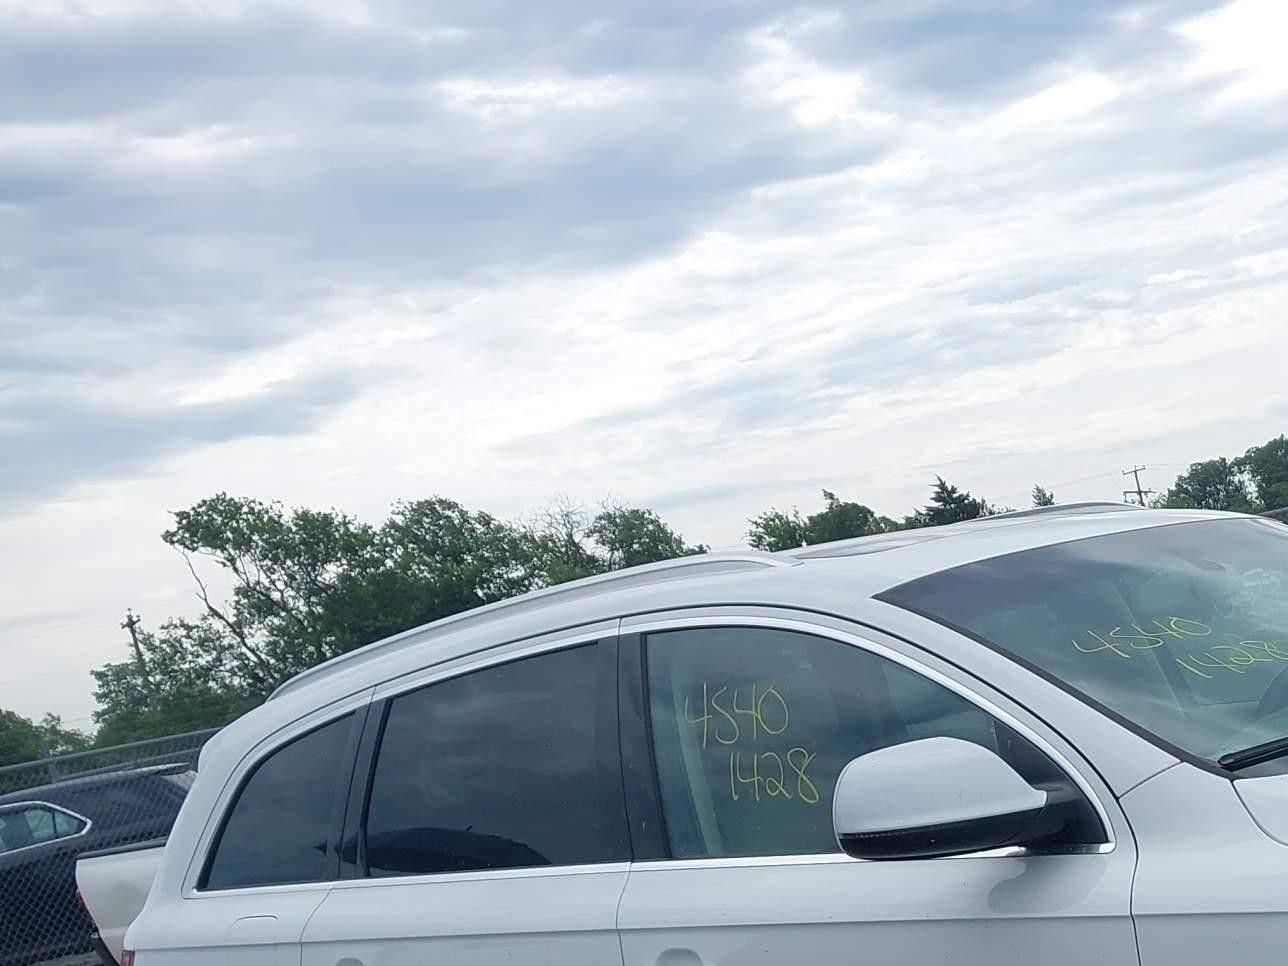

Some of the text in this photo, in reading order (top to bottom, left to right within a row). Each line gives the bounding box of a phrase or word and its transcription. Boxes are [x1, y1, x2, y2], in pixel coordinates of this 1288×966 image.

[1071, 616, 1213, 658] 4540
[684, 682, 789, 749] 4540
[729, 747, 820, 804] 1428
